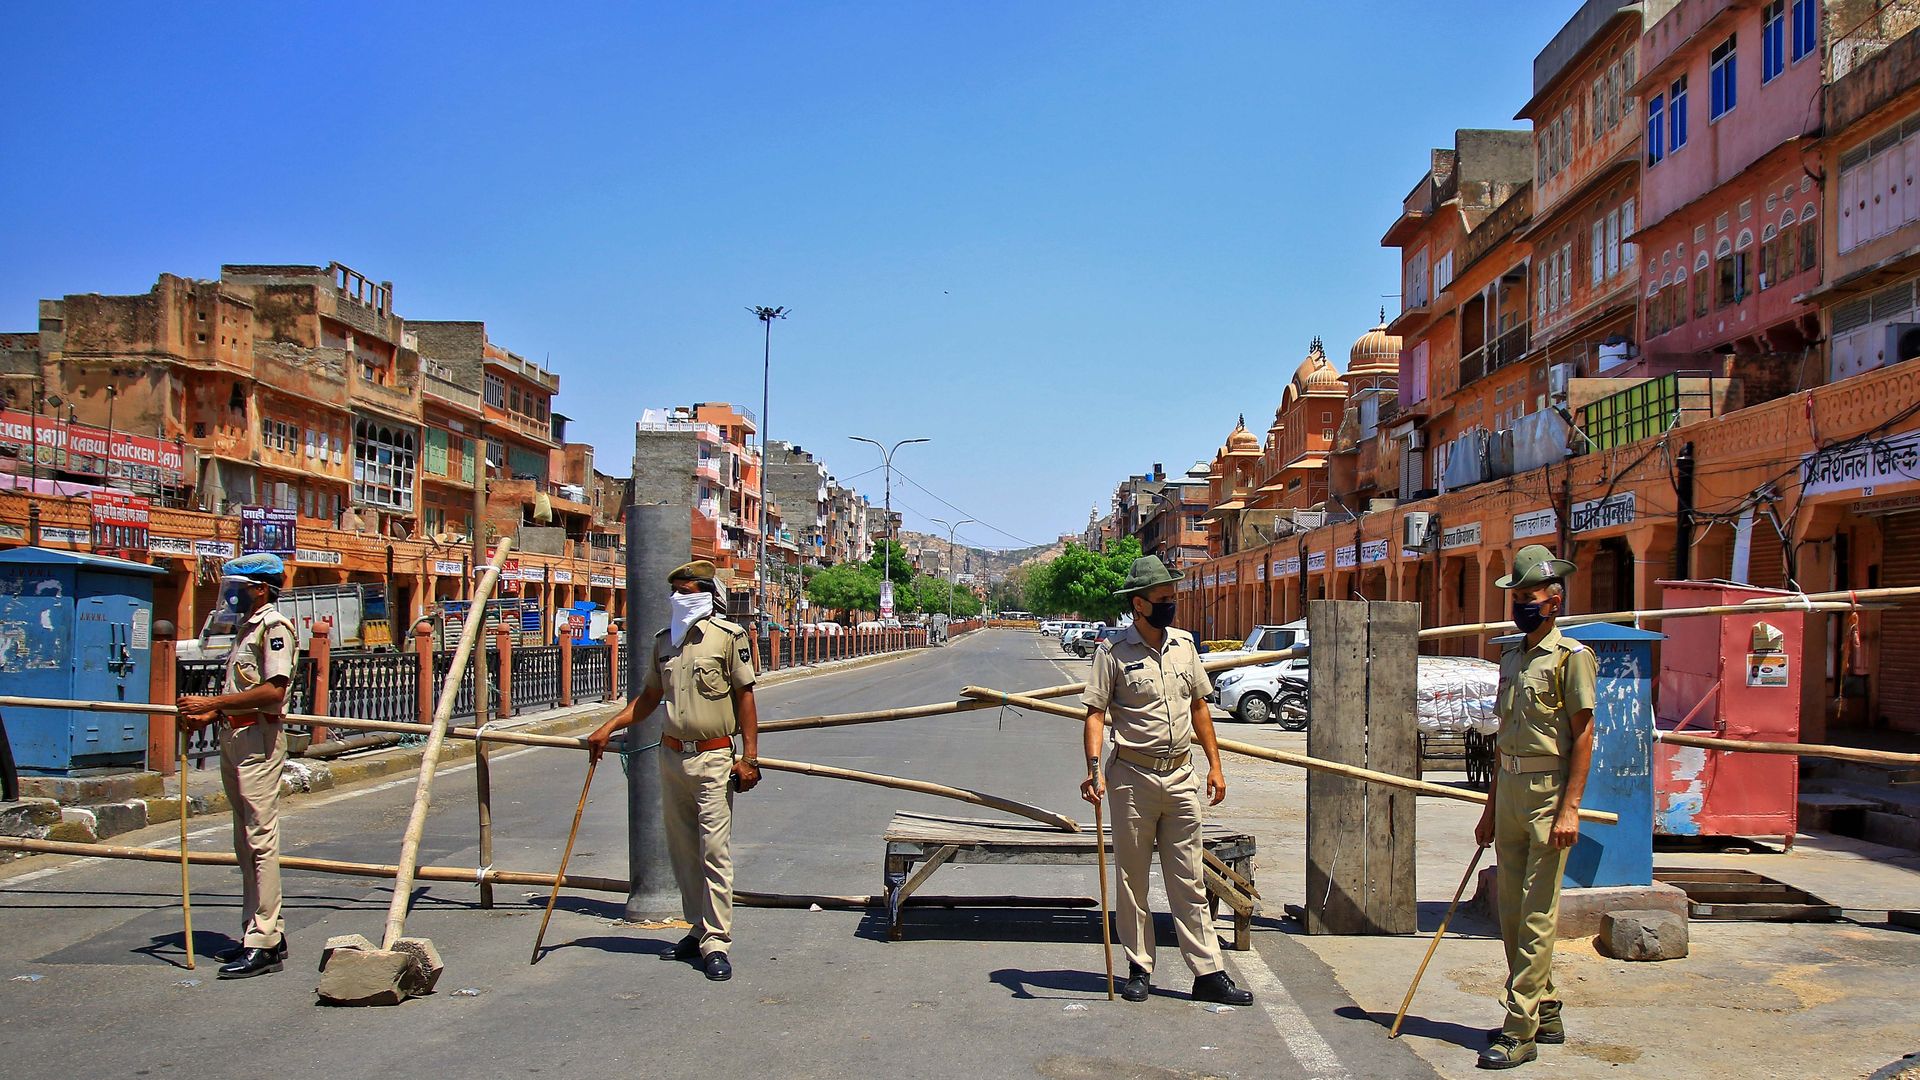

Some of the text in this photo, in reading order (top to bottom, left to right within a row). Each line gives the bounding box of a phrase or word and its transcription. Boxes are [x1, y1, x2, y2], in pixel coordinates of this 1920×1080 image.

[35, 428, 67, 447] SAJJI
[70, 436, 182, 468] KABUL CHICKEN SAJJI
[1864, 487, 1872, 496] 72
[243, 508, 265, 520] शाही
[502, 561, 518, 570] S.K.
